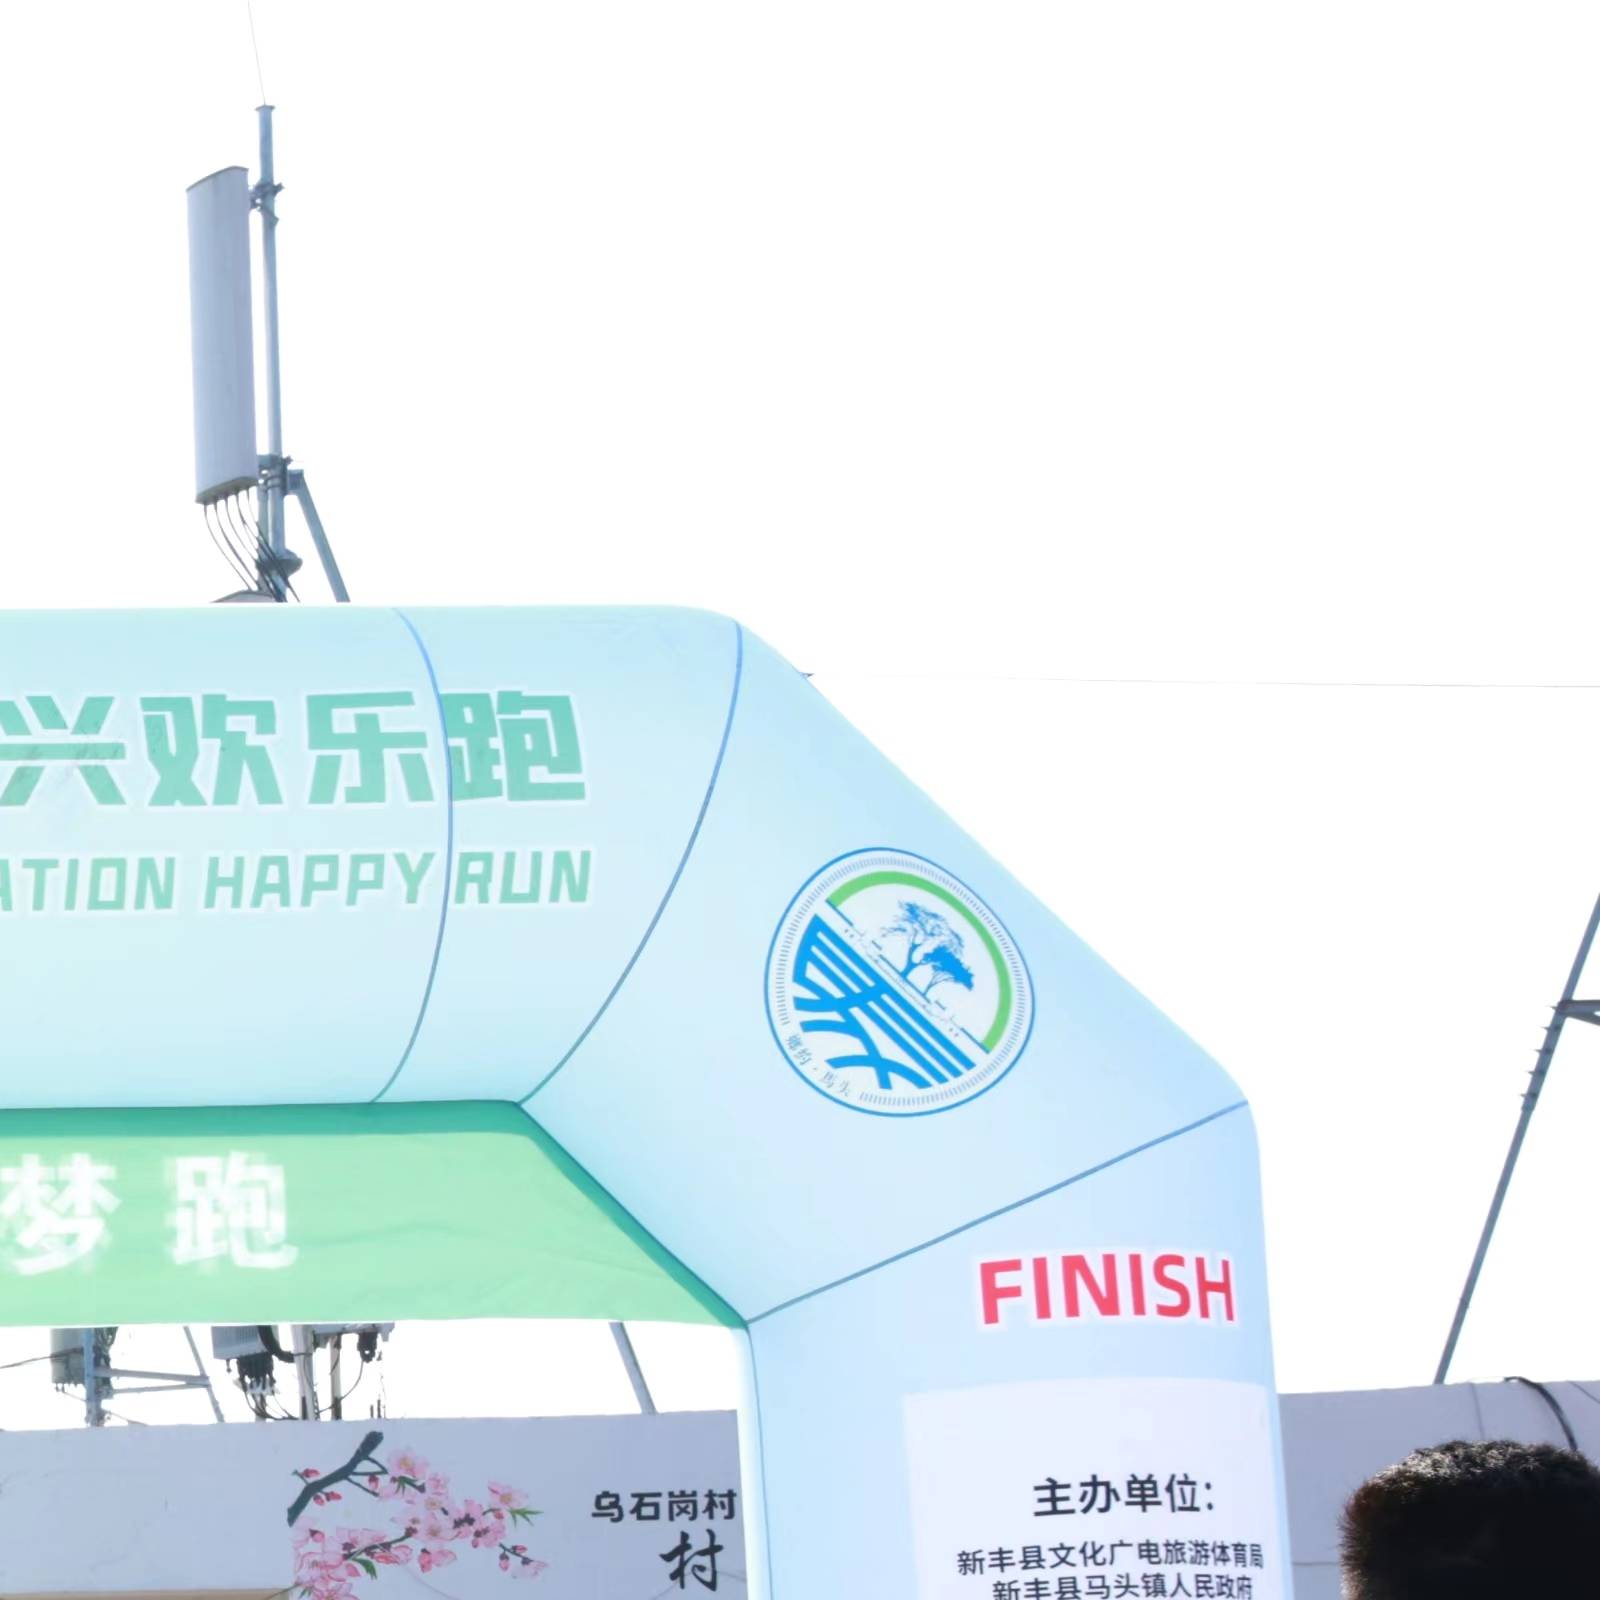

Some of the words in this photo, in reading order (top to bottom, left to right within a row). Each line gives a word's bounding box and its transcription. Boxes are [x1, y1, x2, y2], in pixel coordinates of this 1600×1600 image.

[202, 851, 436, 910] HAPPY
[454, 848, 592, 906] RUN
[980, 1253, 1235, 1325] FINISH
[591, 1489, 737, 1523] 乌石岗村
[1033, 1474, 1214, 1517] 主办单位：
[659, 1528, 724, 1592] 村
[957, 1540, 1263, 1577] 新丰县文化广电旅游体育局
